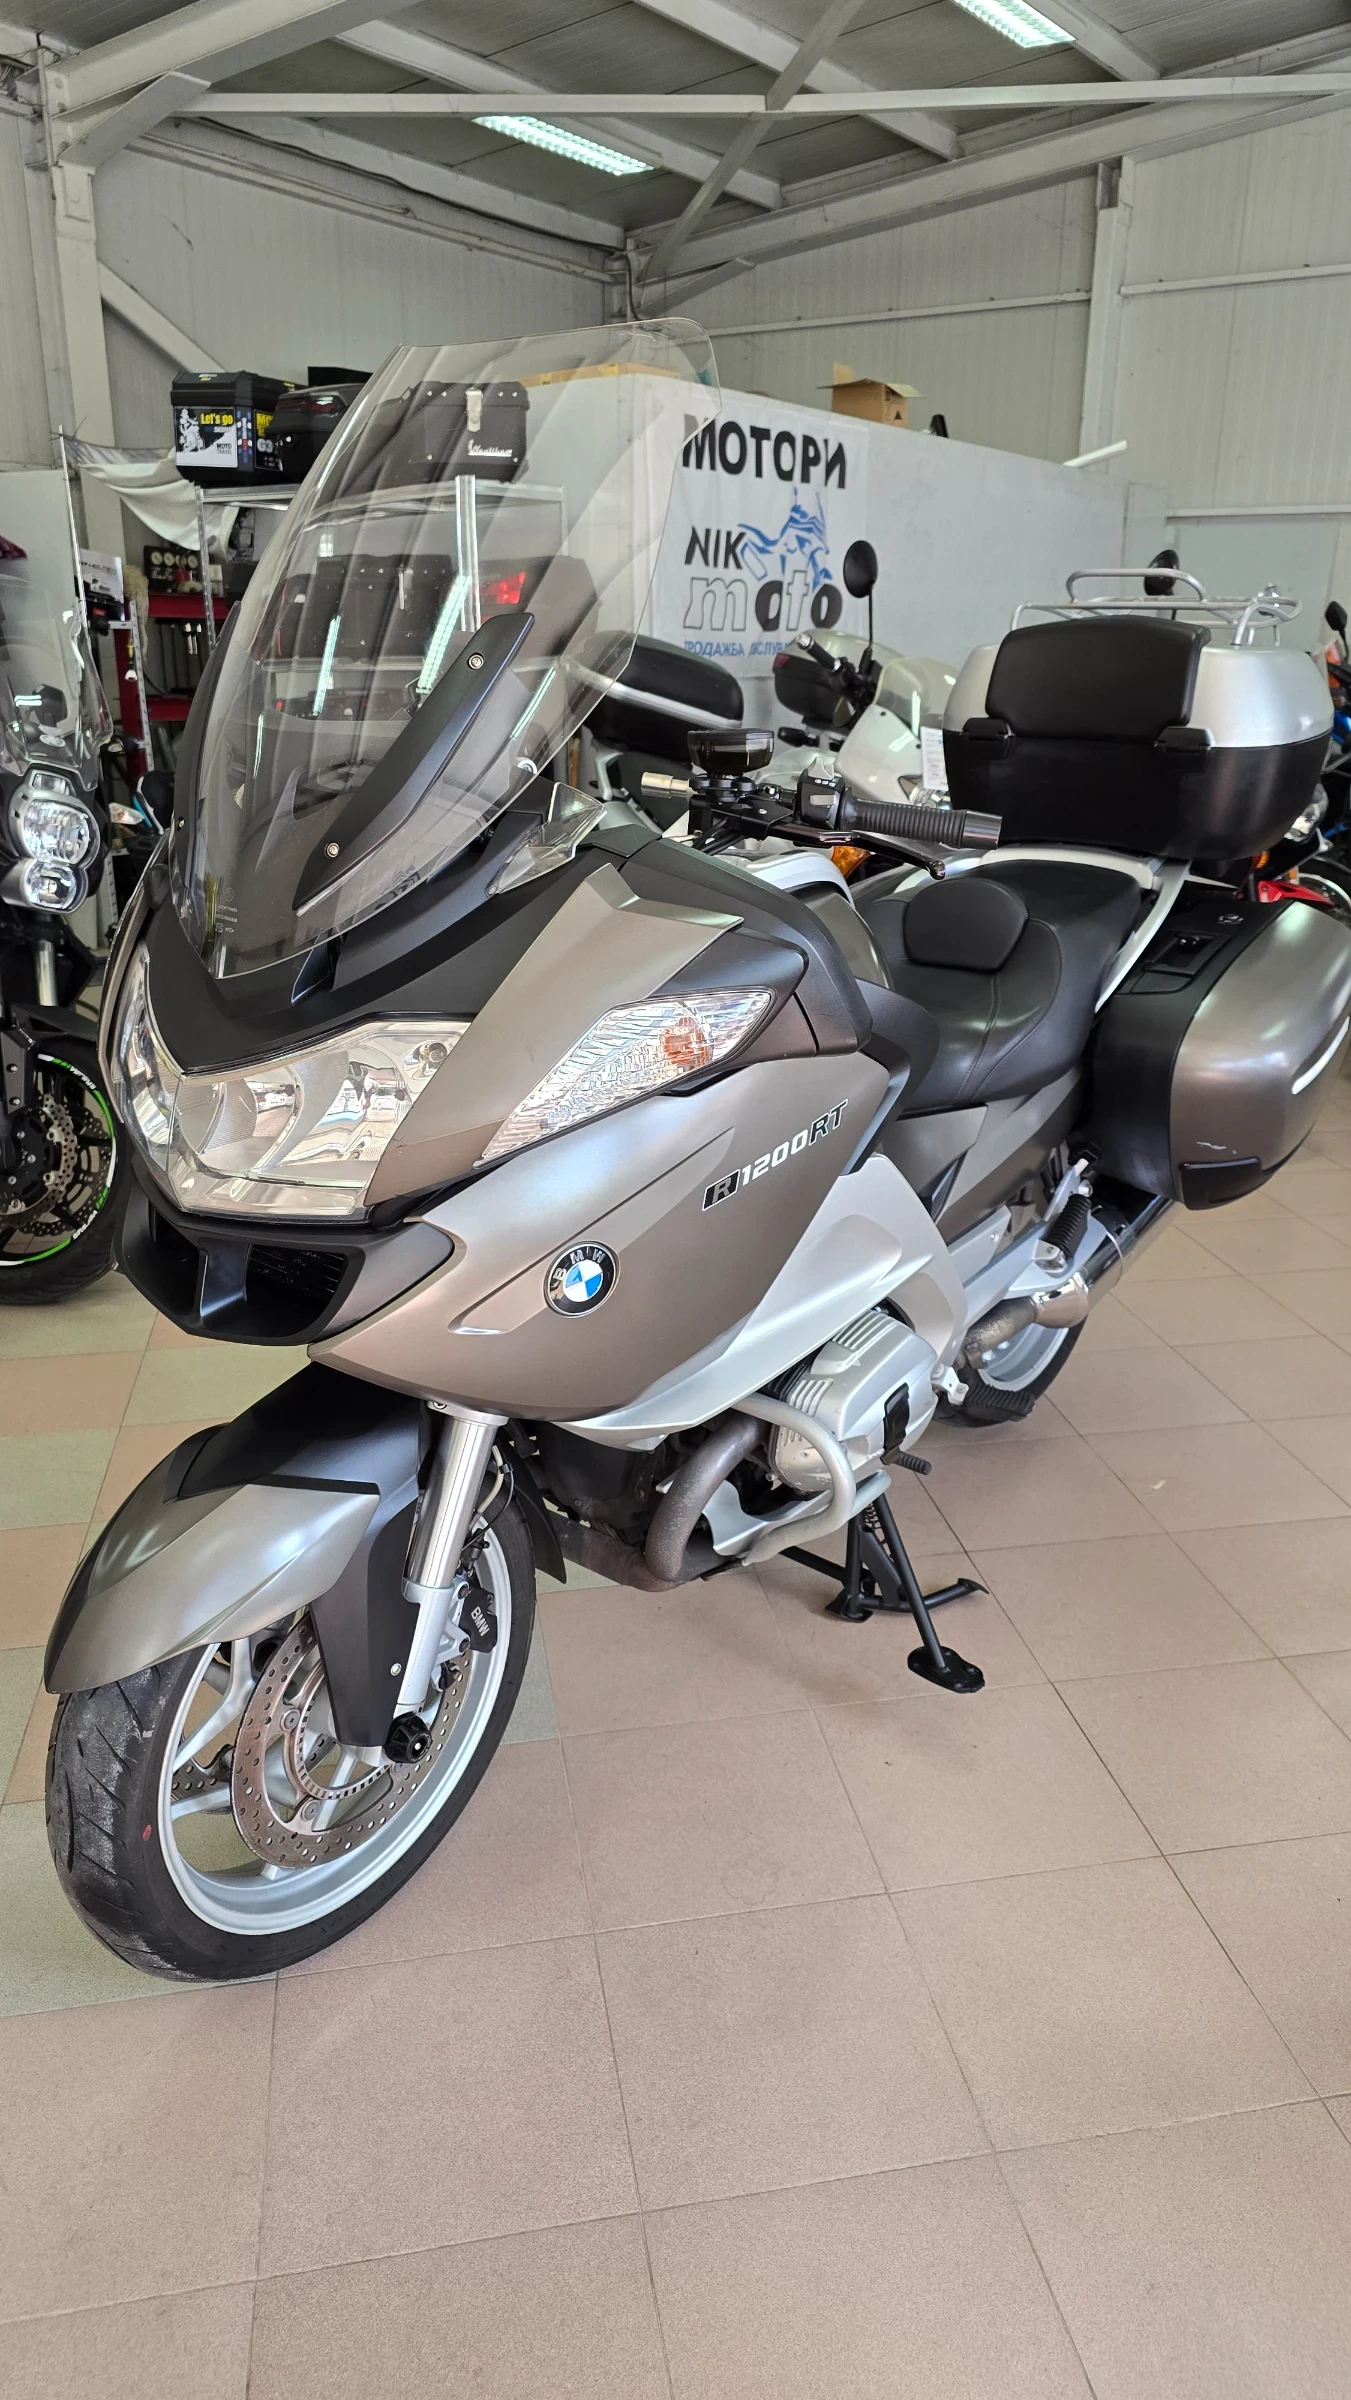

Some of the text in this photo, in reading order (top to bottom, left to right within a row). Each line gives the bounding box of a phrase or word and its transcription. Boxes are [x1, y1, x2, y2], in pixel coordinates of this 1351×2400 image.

[222, 414, 234, 426] go
[682, 413, 847, 489] МОТОРИ
[684, 526, 747, 570] NIK
[553, 1248, 607, 1281] BMW
[471, 1606, 490, 1637] BMW
